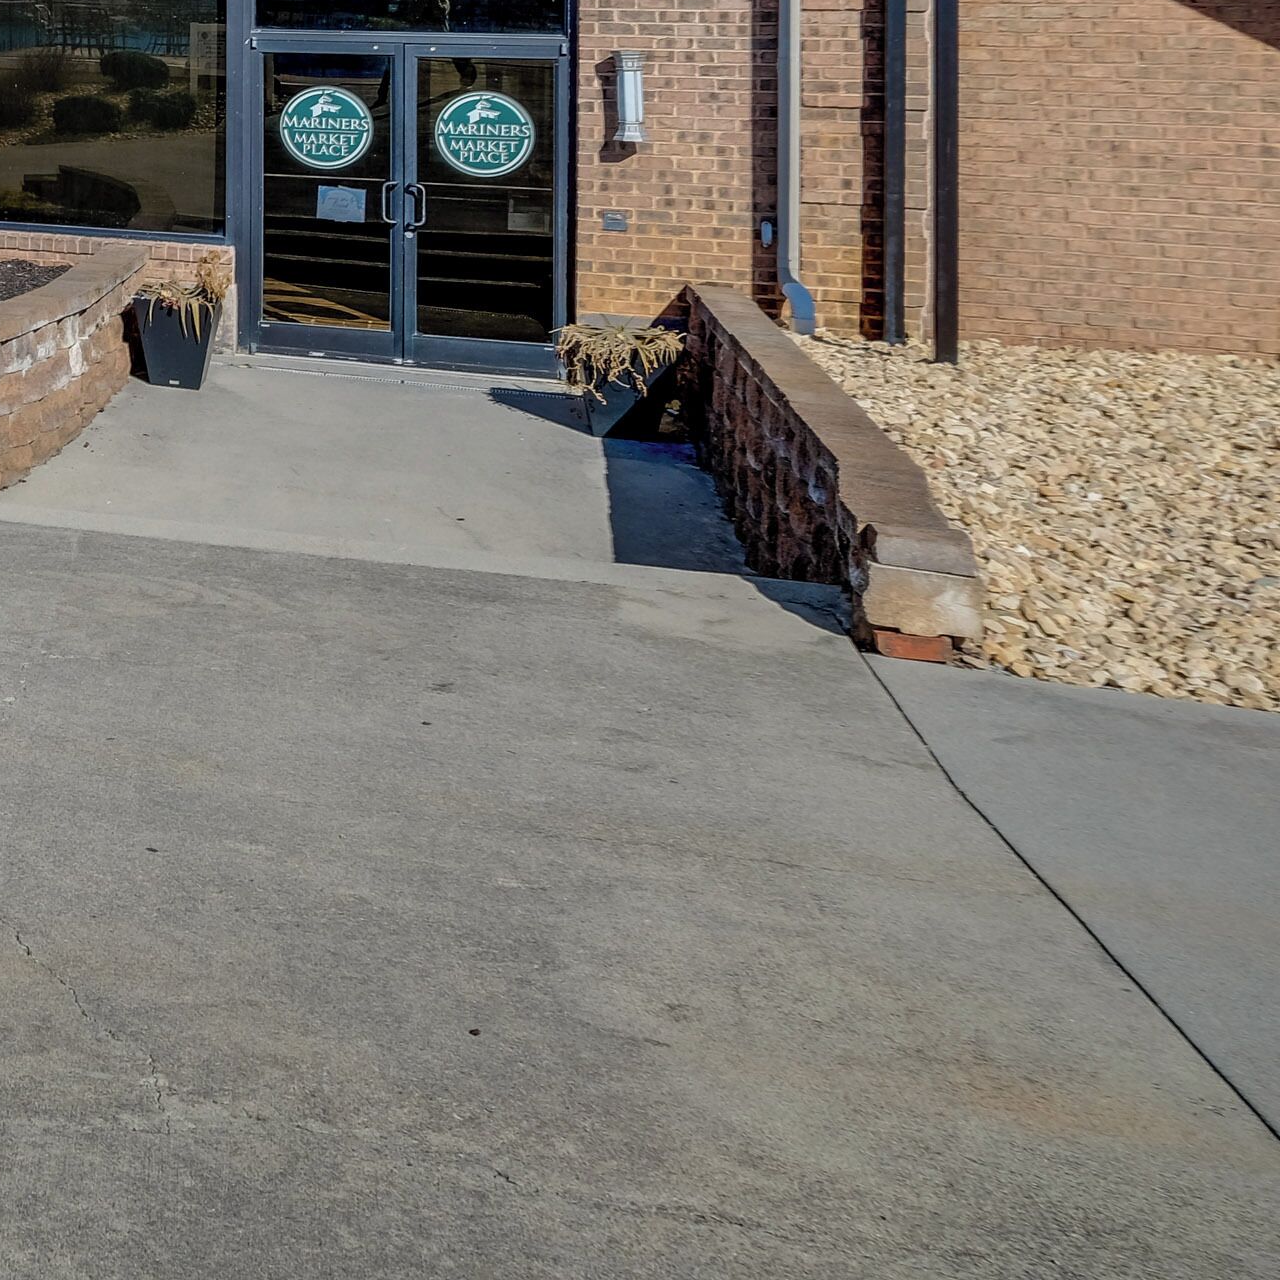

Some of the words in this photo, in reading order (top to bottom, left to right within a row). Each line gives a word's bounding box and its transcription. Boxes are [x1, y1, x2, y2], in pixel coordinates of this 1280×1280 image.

[282, 114, 370, 131] MARINERS
[437, 121, 531, 137] MARINERS
[294, 132, 359, 146] MARKET
[449, 139, 520, 153] MARKET
[302, 144, 350, 156] PLACE
[459, 151, 510, 164] PLACE
